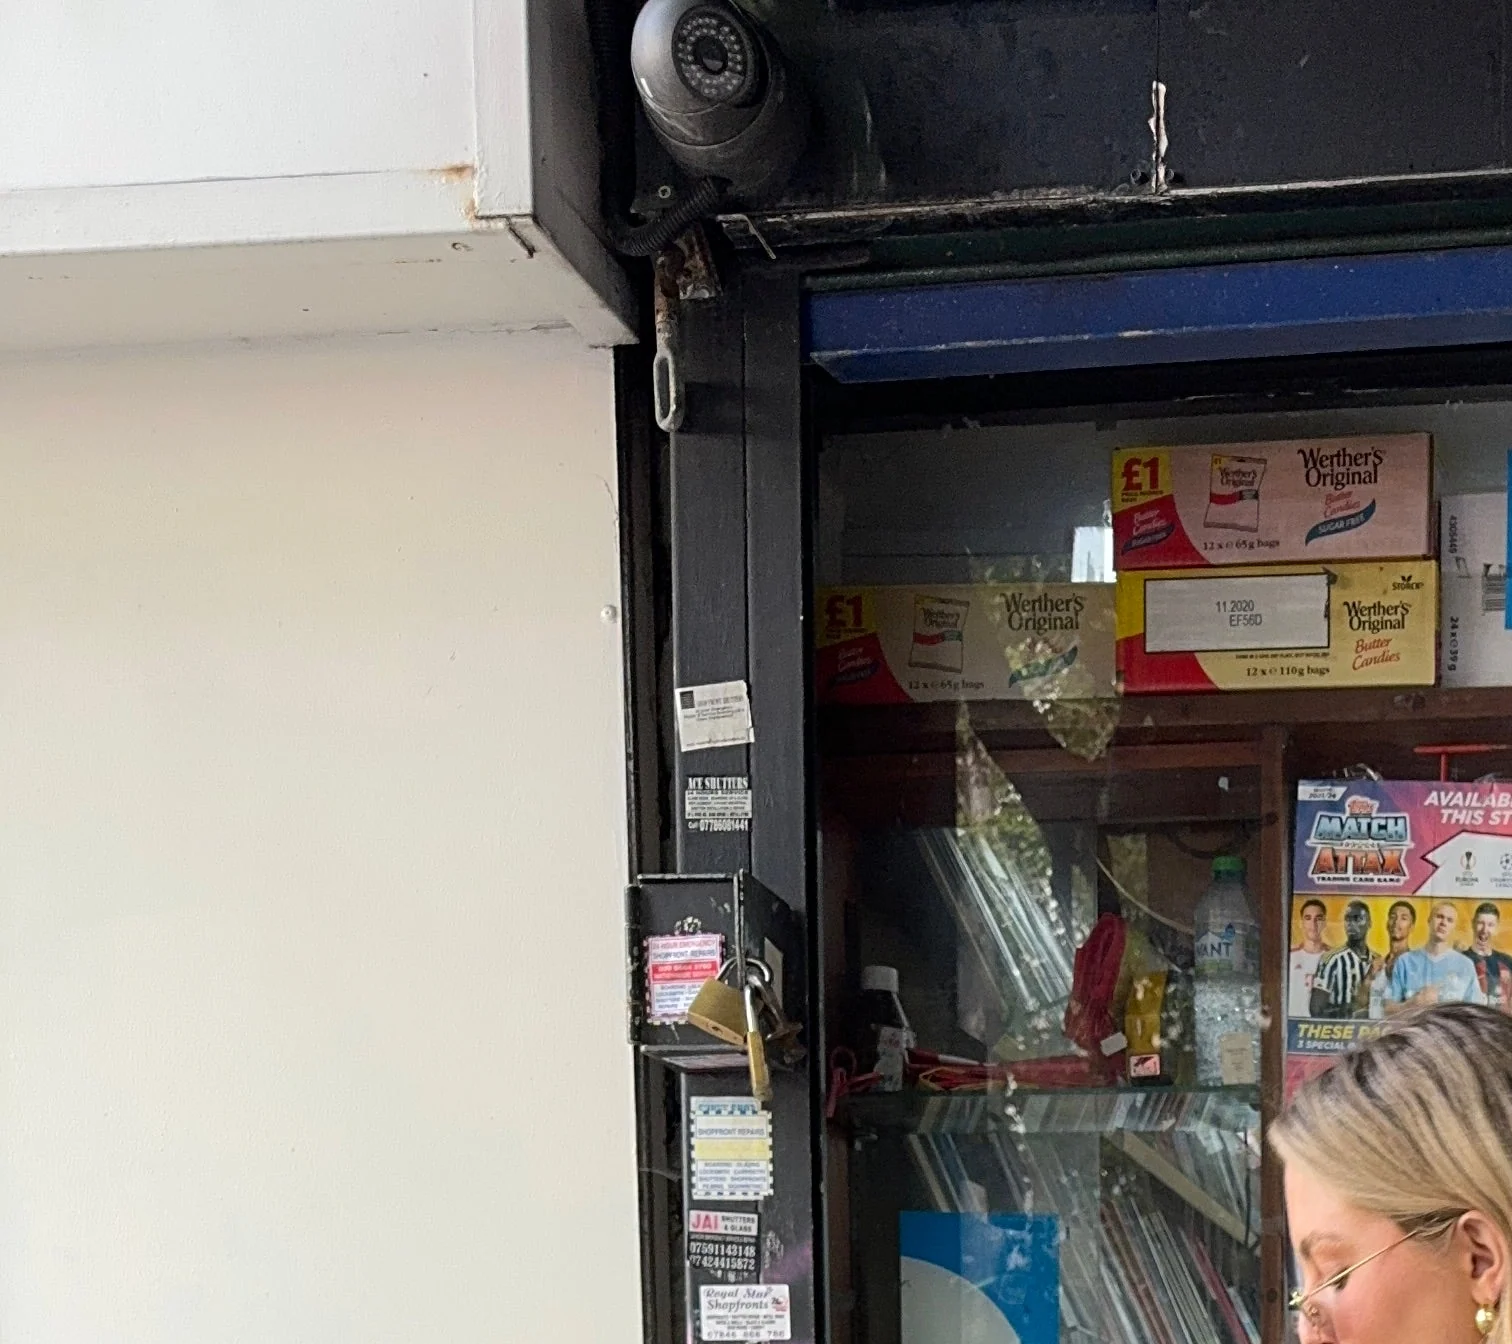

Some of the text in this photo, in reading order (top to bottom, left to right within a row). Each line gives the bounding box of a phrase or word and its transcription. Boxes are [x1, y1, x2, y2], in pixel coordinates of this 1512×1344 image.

[1298, 448, 1384, 469] Werther's
[1121, 457, 1159, 492] £1
[1305, 466, 1379, 491] Original
[1203, 538, 1280, 550] 12 bags
[1000, 593, 1085, 613] Werther's
[1216, 600, 1255, 613] 11.2020
[1343, 600, 1410, 616] Werther's
[1008, 610, 1080, 634] Original
[1348, 613, 1406, 634] Original
[1354, 637, 1393, 654] Butter
[1351, 650, 1401, 670] Candies
[1247, 665, 1330, 677] 12 bags
[688, 777, 748, 790] ACE SHUTTERS
[1440, 809, 1484, 825] THIS
[1313, 814, 1408, 841] MATCH
[1311, 847, 1407, 876] ATTAX
[1298, 1024, 1355, 1040] THESE
[1305, 1040, 1348, 1050] SPECIAL
[691, 1213, 719, 1231] JAI
[721, 1215, 756, 1224] SHUTTERS
[704, 1287, 739, 1299] Royal
[708, 1298, 769, 1313] Shopfronts
